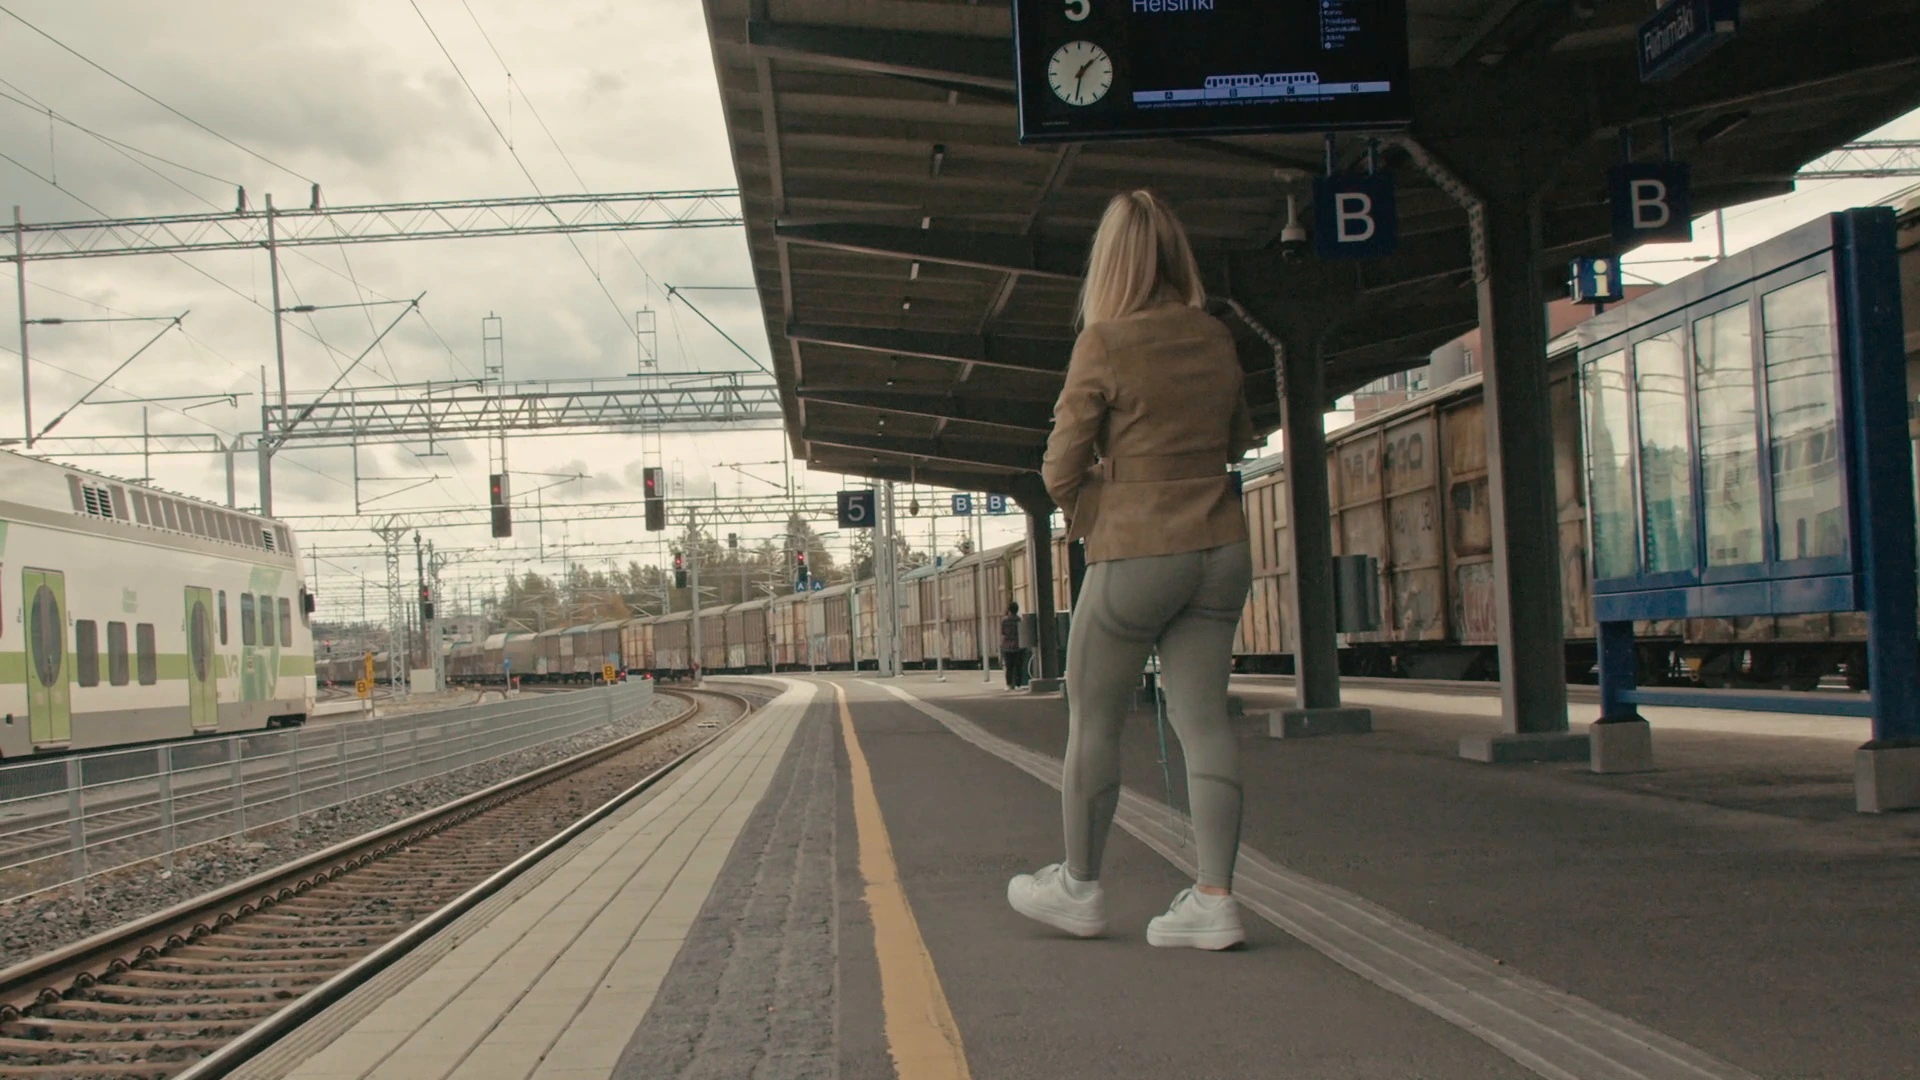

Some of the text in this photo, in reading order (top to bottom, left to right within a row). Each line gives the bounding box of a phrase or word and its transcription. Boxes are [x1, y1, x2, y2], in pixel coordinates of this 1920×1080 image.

[1064, 0, 1091, 22] 5
[1132, 0, 1214, 13] Helsinki
[1630, 179, 1670, 229] B
[1335, 192, 1375, 243] B
[847, 496, 865, 522] 5
[956, 497, 967, 511] B
[990, 495, 1001, 509] B
[797, 582, 805, 591] A
[814, 581, 822, 590] A
[604, 666, 613, 676] B
[357, 682, 366, 693] B
